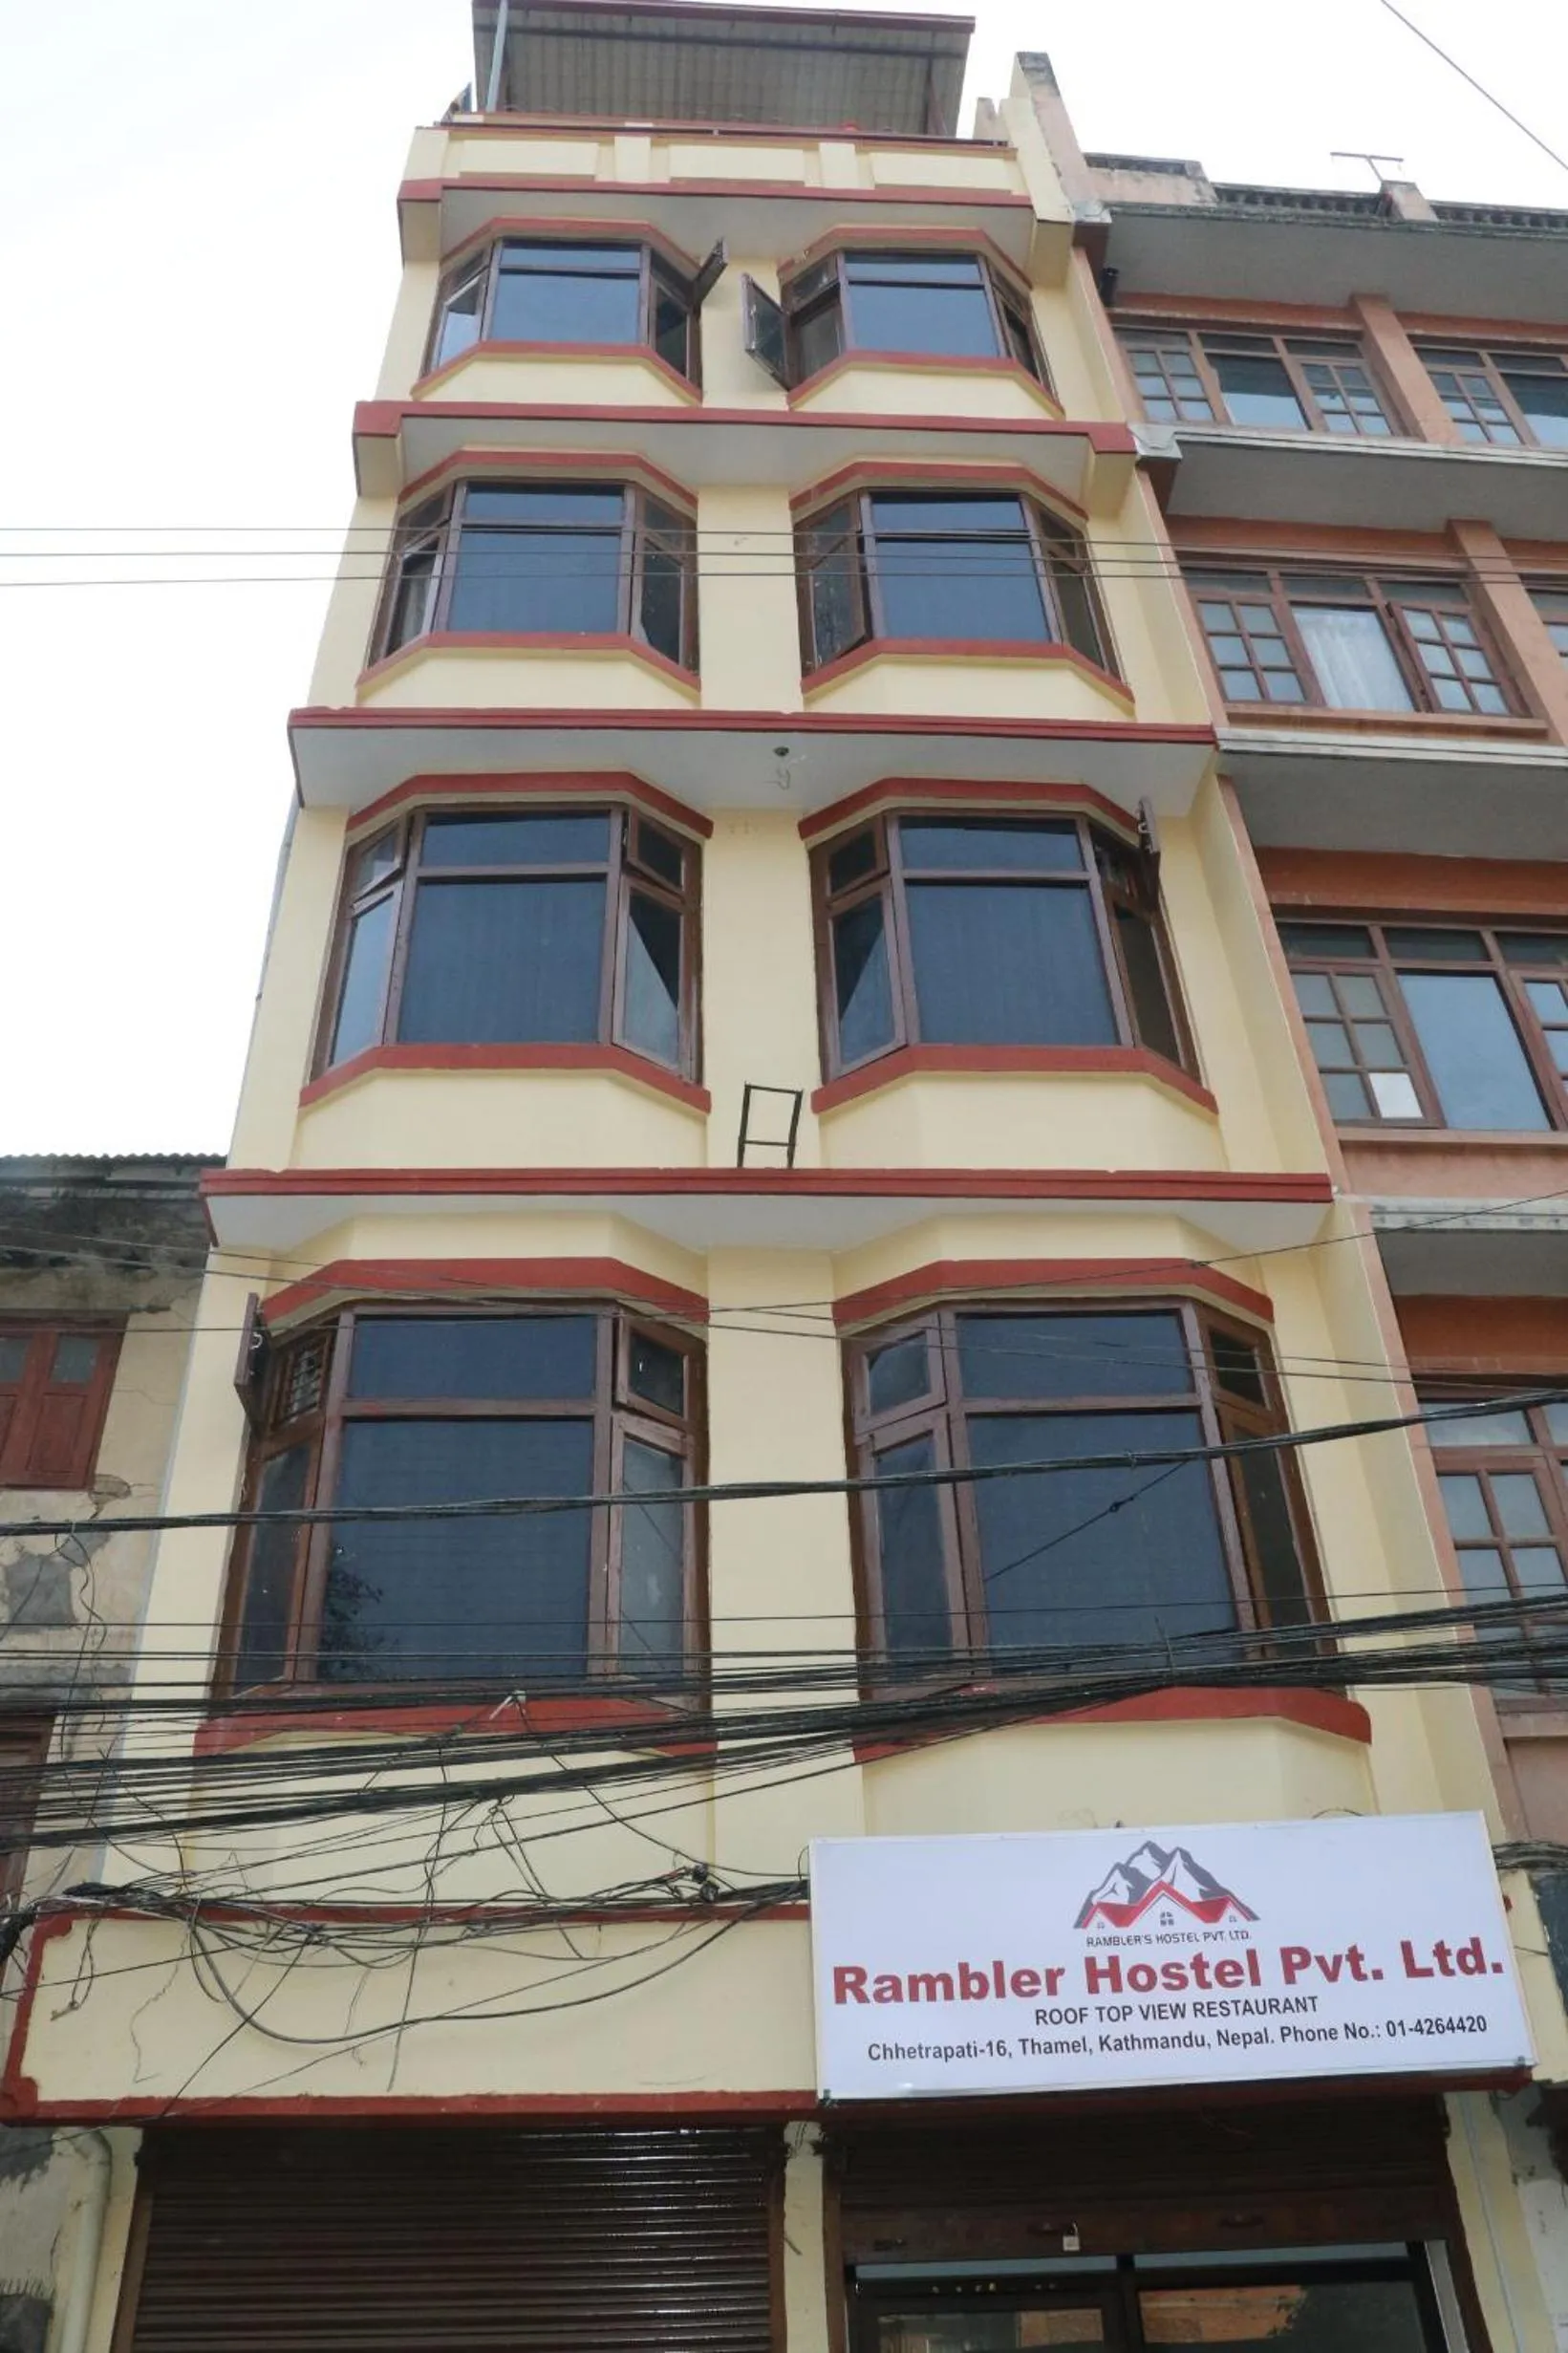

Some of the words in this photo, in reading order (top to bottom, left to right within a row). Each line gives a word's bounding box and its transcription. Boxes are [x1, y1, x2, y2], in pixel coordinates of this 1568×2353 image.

[1086, 1933, 1152, 1947] RAMBLER'S
[1156, 1932, 1199, 1944] HOSTEL
[833, 1960, 1065, 2004] Rambler
[1085, 1948, 1261, 1996] Hostel
[1279, 1944, 1385, 1985] Pvt.
[1400, 1936, 1504, 1978] Ltd.
[1035, 2007, 1088, 2025] ROOF
[1096, 2005, 1134, 2023] TOP
[1139, 2002, 1187, 2020] VIEW
[1193, 1996, 1319, 2018] RESTAURANT
[868, 2040, 1013, 2062] Chhetrapati-16,
[1019, 2036, 1093, 2056] Thamel,
[1099, 2030, 1212, 2052] Kathmandu,
[1216, 2028, 1275, 2049] Nepal.
[1280, 2024, 1339, 2043] Phone
[1344, 2022, 1380, 2040] No.:
[1386, 2015, 1488, 2038] 01-4264420
